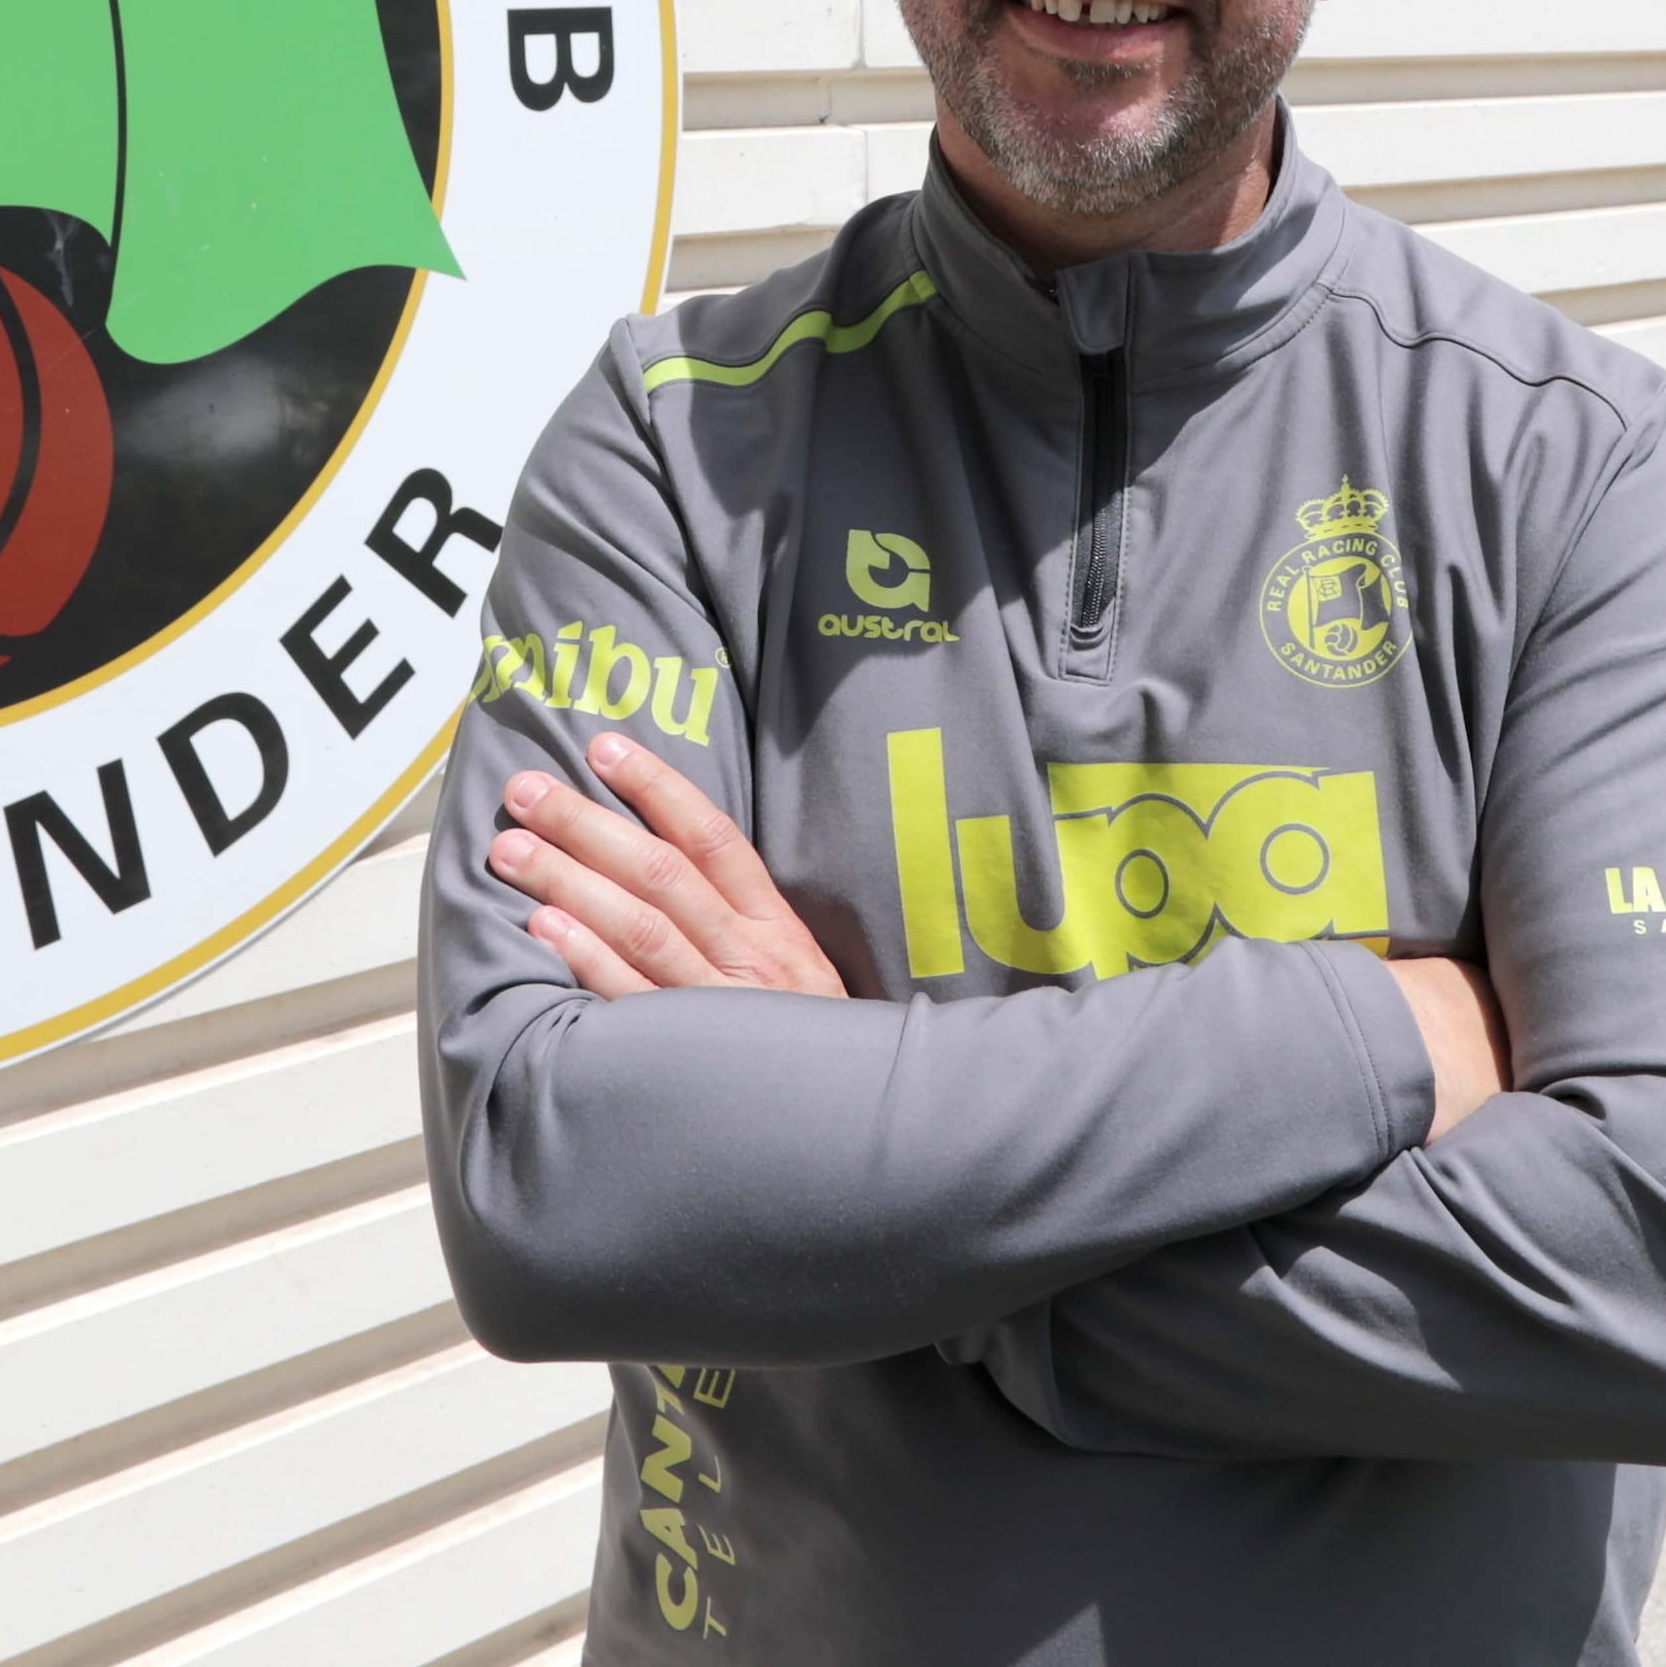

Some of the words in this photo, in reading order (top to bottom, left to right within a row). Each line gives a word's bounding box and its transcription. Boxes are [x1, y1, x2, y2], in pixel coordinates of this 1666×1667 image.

[1266, 563, 1300, 612] REAL
[1300, 537, 1379, 565] RACING
[1379, 553, 1410, 609] CLUB
[817, 613, 961, 643] austral
[1280, 640, 1398, 681] SANTANDER
[886, 727, 1390, 981] lupa
